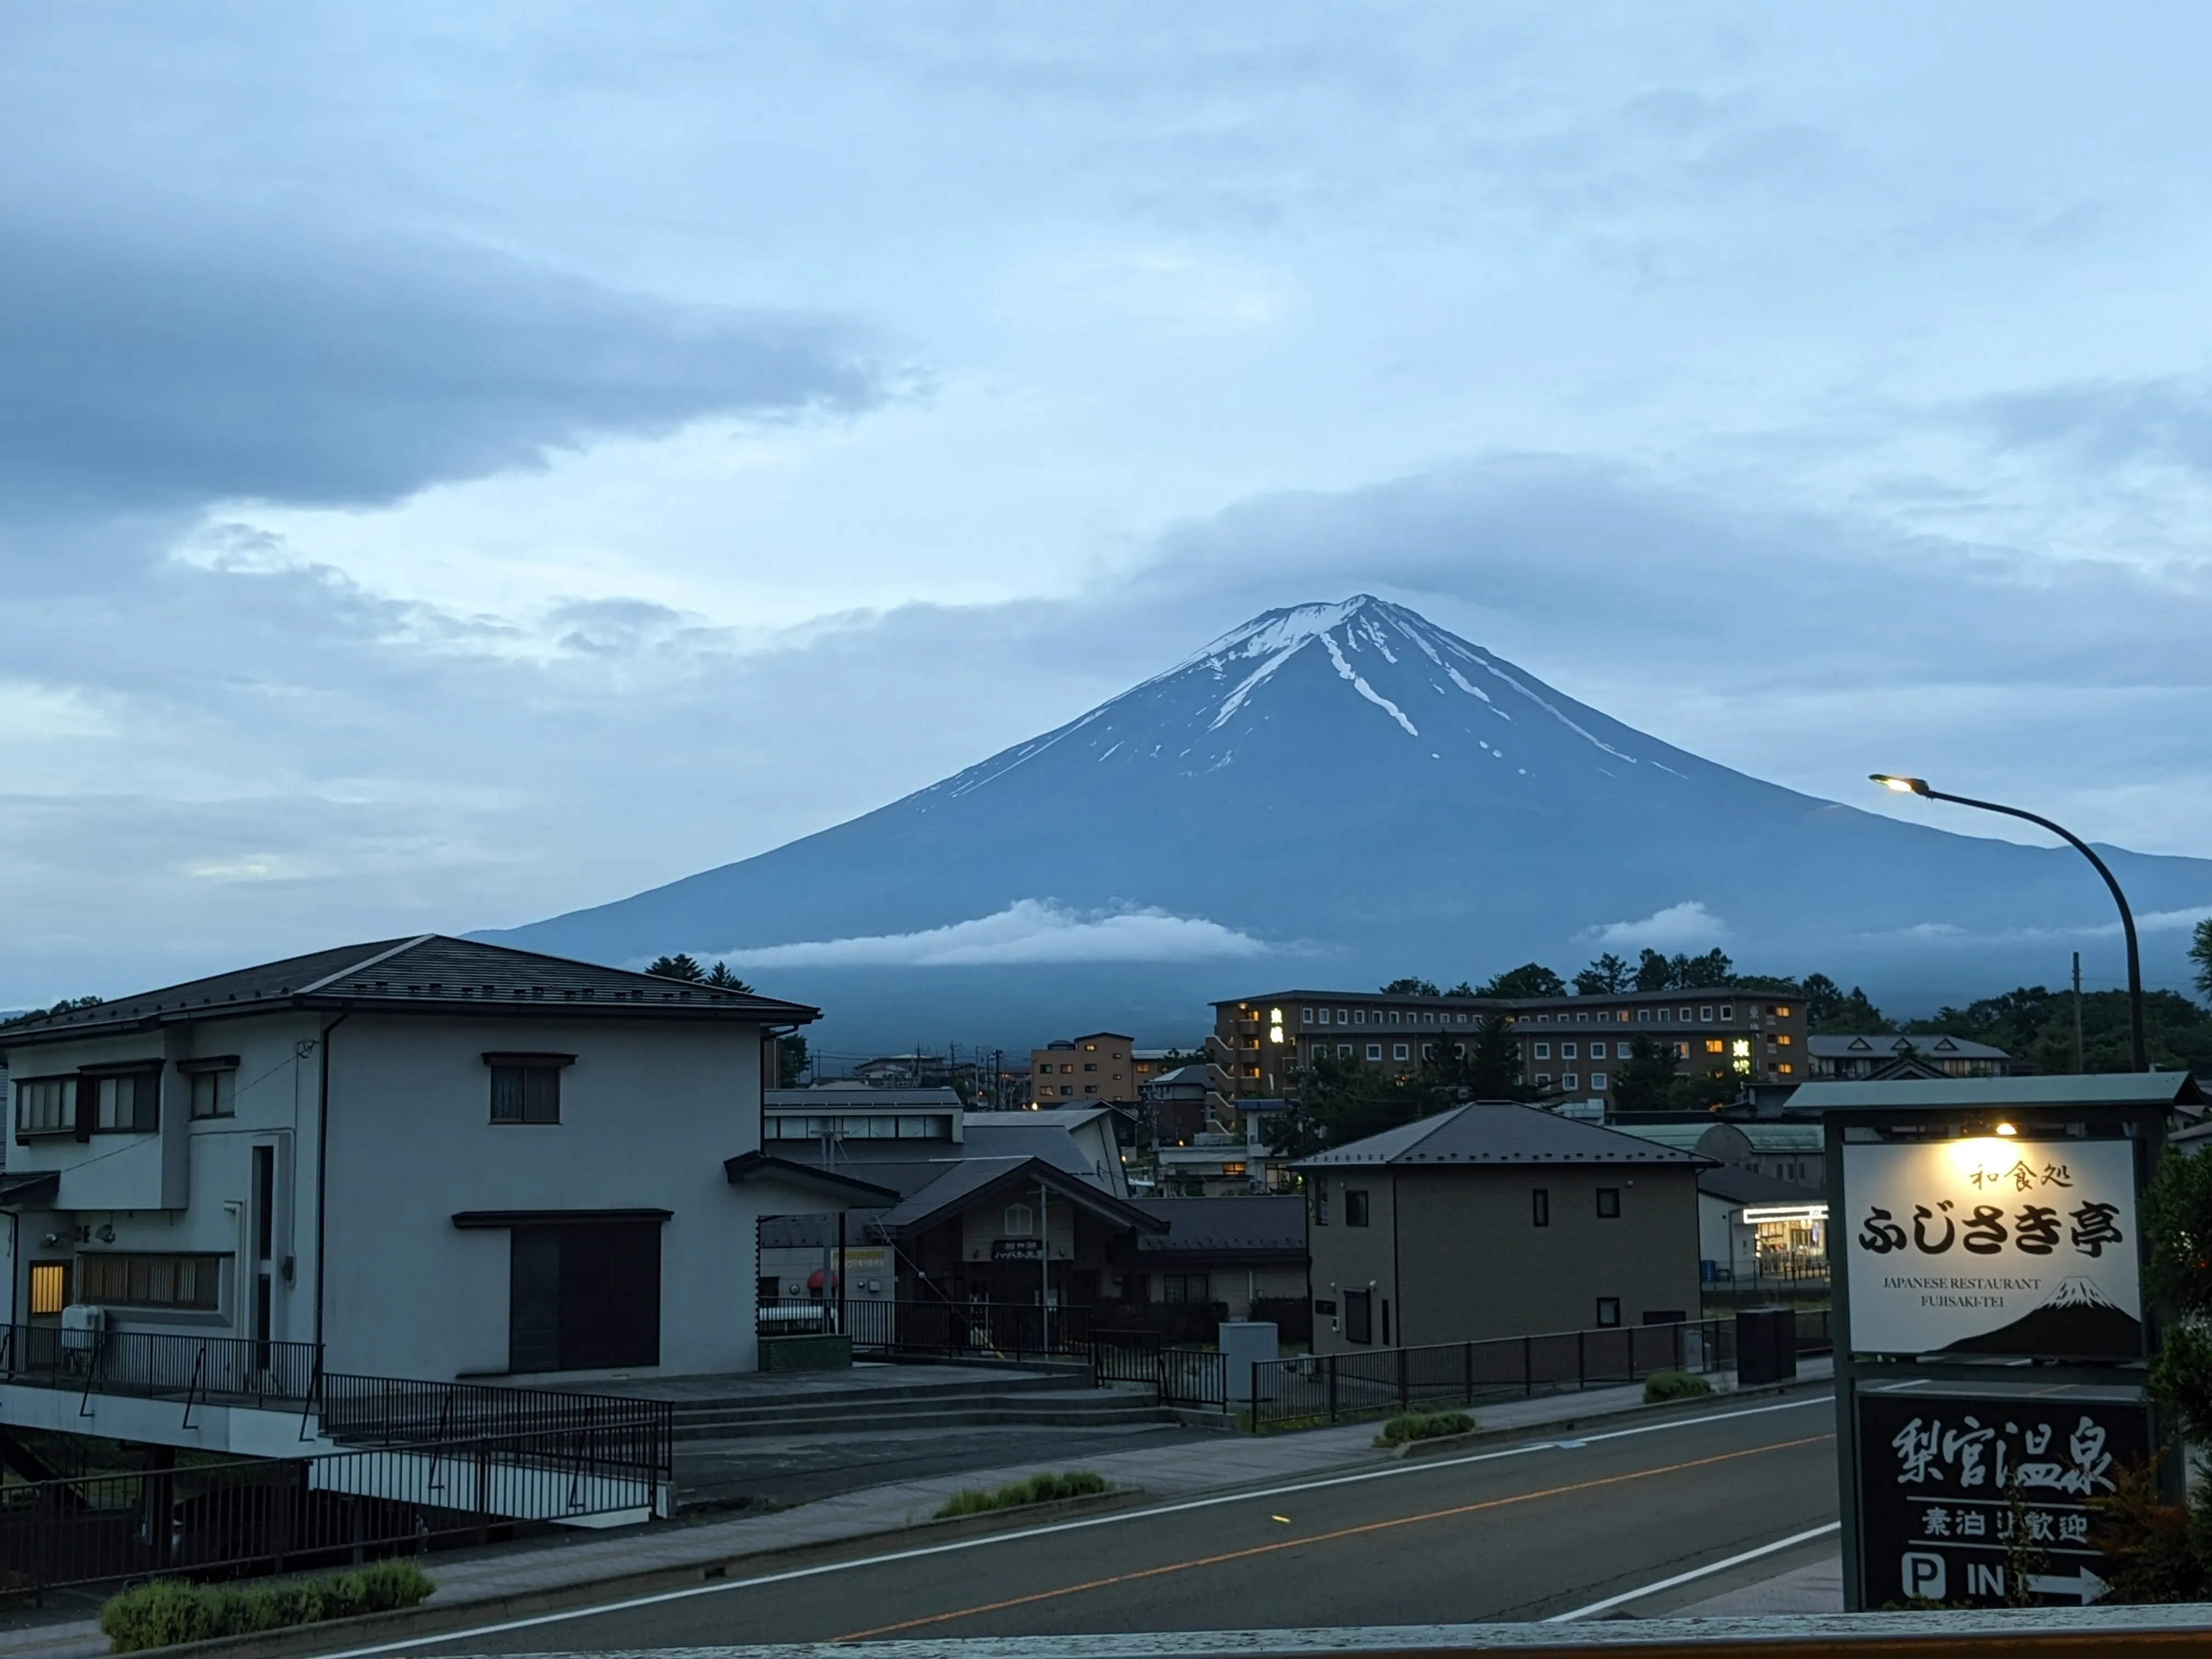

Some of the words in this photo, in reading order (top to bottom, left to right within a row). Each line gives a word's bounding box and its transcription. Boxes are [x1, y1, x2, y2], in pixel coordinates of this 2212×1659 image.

[1968, 1160, 2074, 1193] 和食処
[1858, 1199, 2124, 1259] ふじさき亭
[1882, 1277, 1948, 1290] JAPANESE
[1950, 1277, 2041, 1290] RESTAURANT
[1921, 1295, 2005, 1308] FUJISAKI-TEI
[1910, 1558, 1939, 1595] P
[1967, 1562, 2005, 1596] IN
